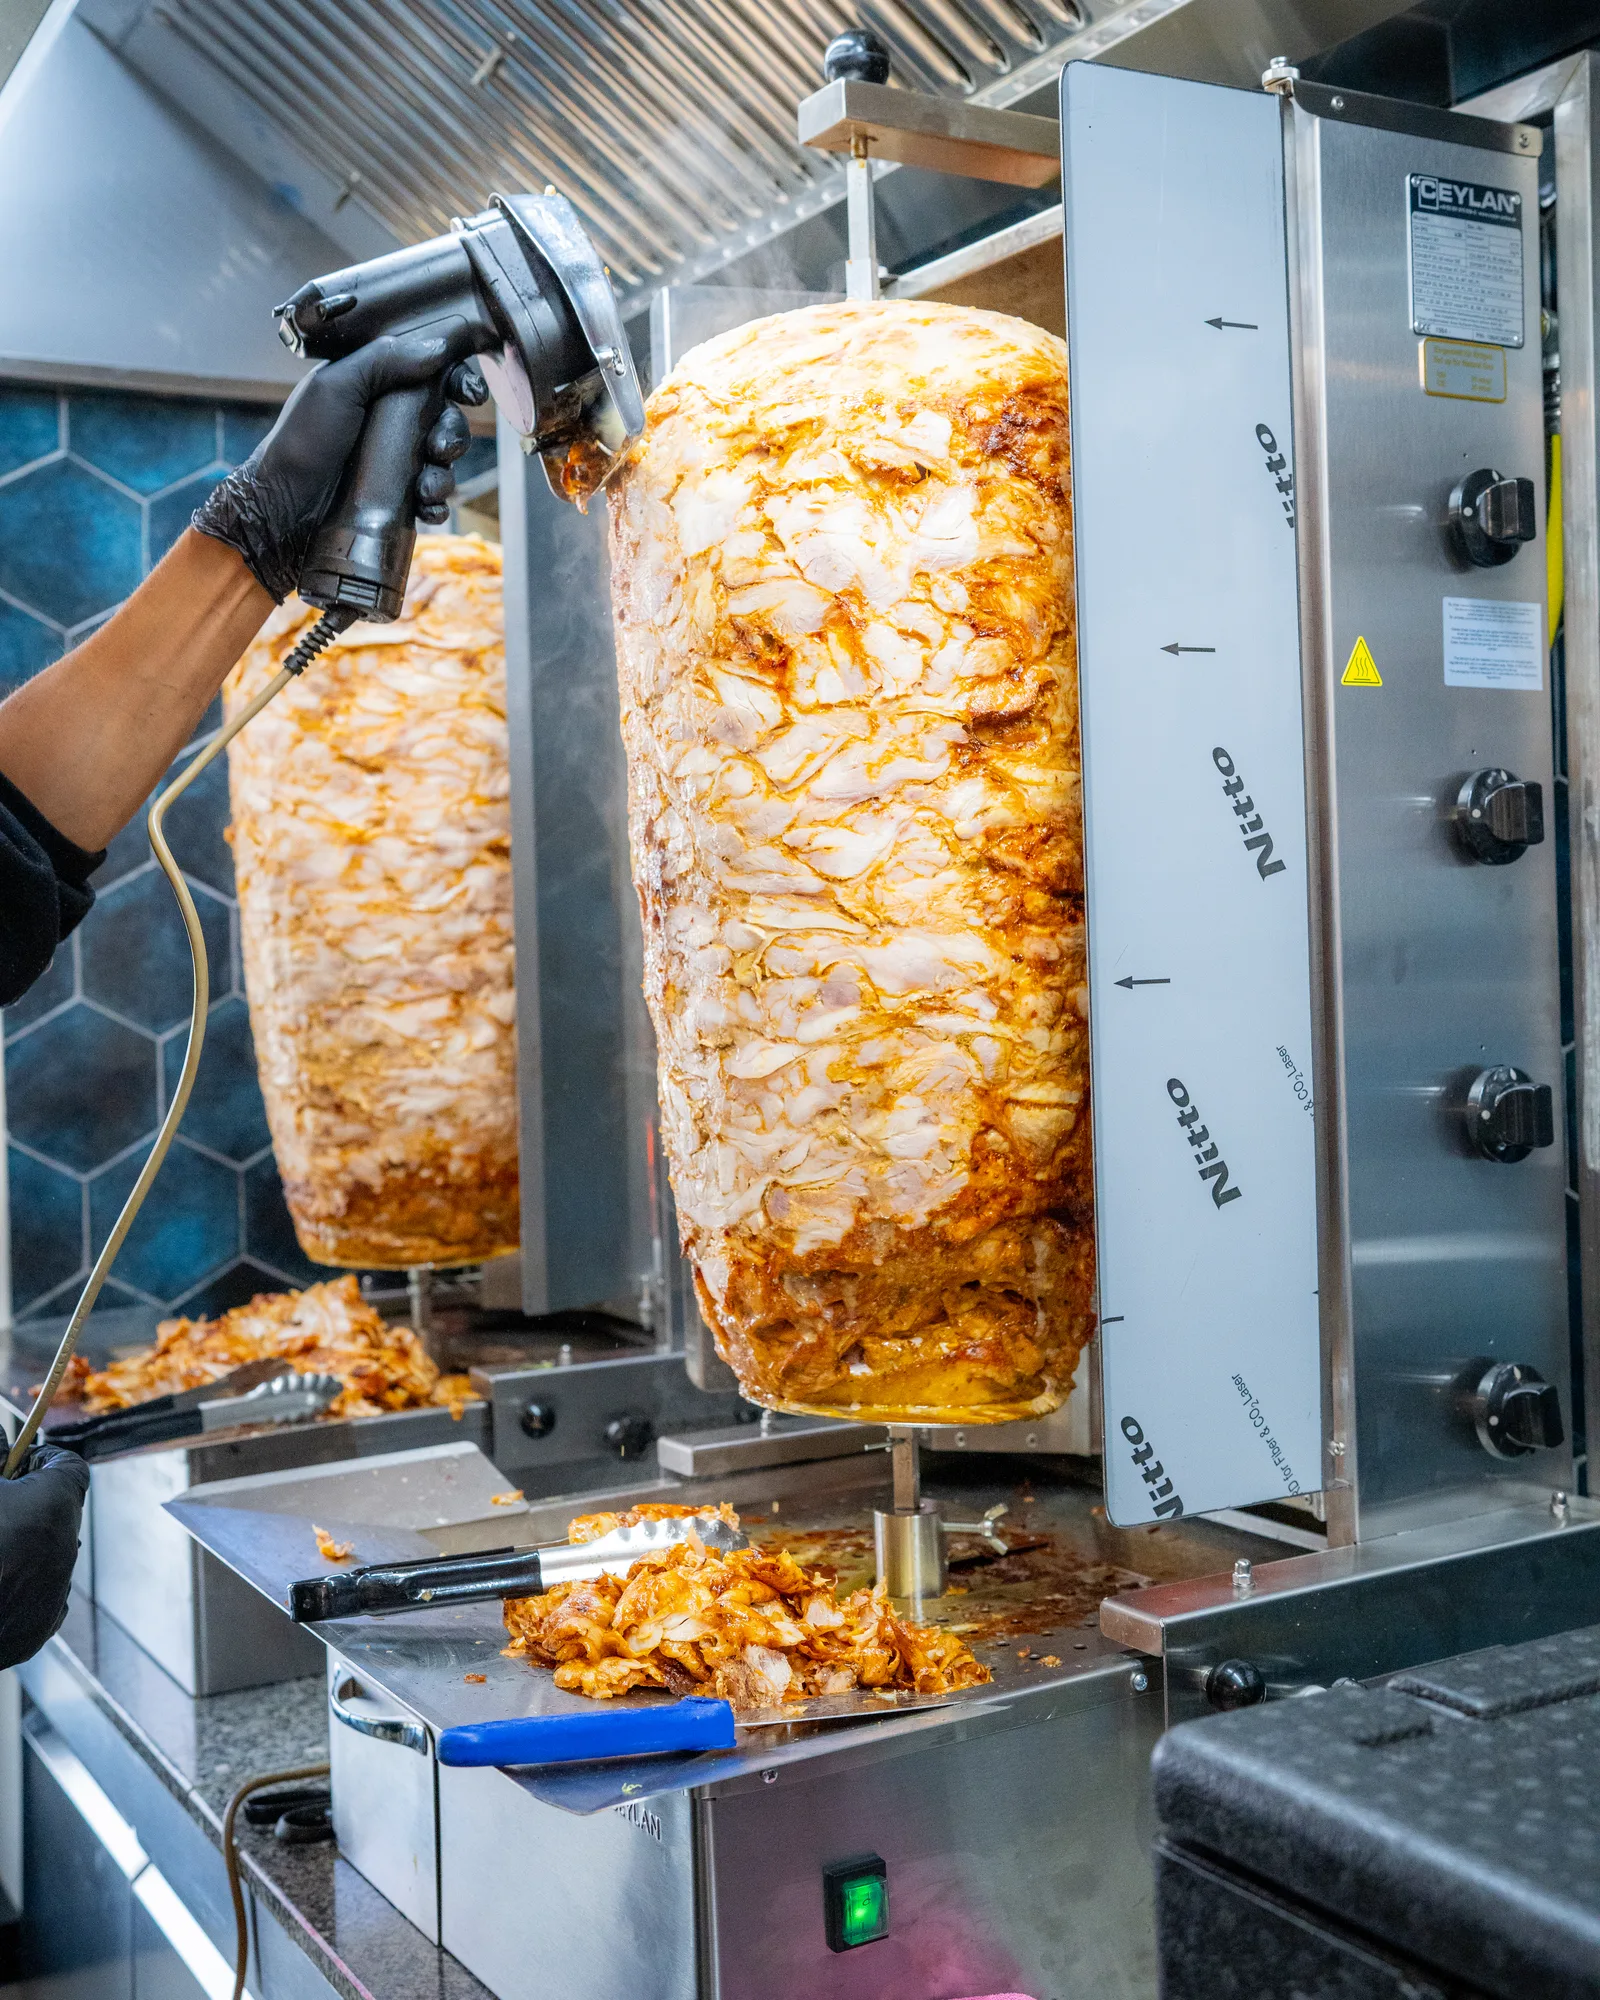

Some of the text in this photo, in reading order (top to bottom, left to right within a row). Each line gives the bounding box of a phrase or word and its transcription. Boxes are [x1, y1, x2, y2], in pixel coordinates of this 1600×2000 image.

[1420, 179, 1515, 214] CEYLAN
[1255, 423, 1294, 529] itto
[1212, 746, 1287, 882] Nitto
[1275, 1044, 1297, 1078] Laser
[1166, 1077, 1242, 1210] Nitto
[1231, 1373, 1253, 1406] Laser
[1259, 1425, 1270, 1438] &
[1265, 1437, 1285, 1467] Fiber
[1280, 1464, 1293, 1482] for
